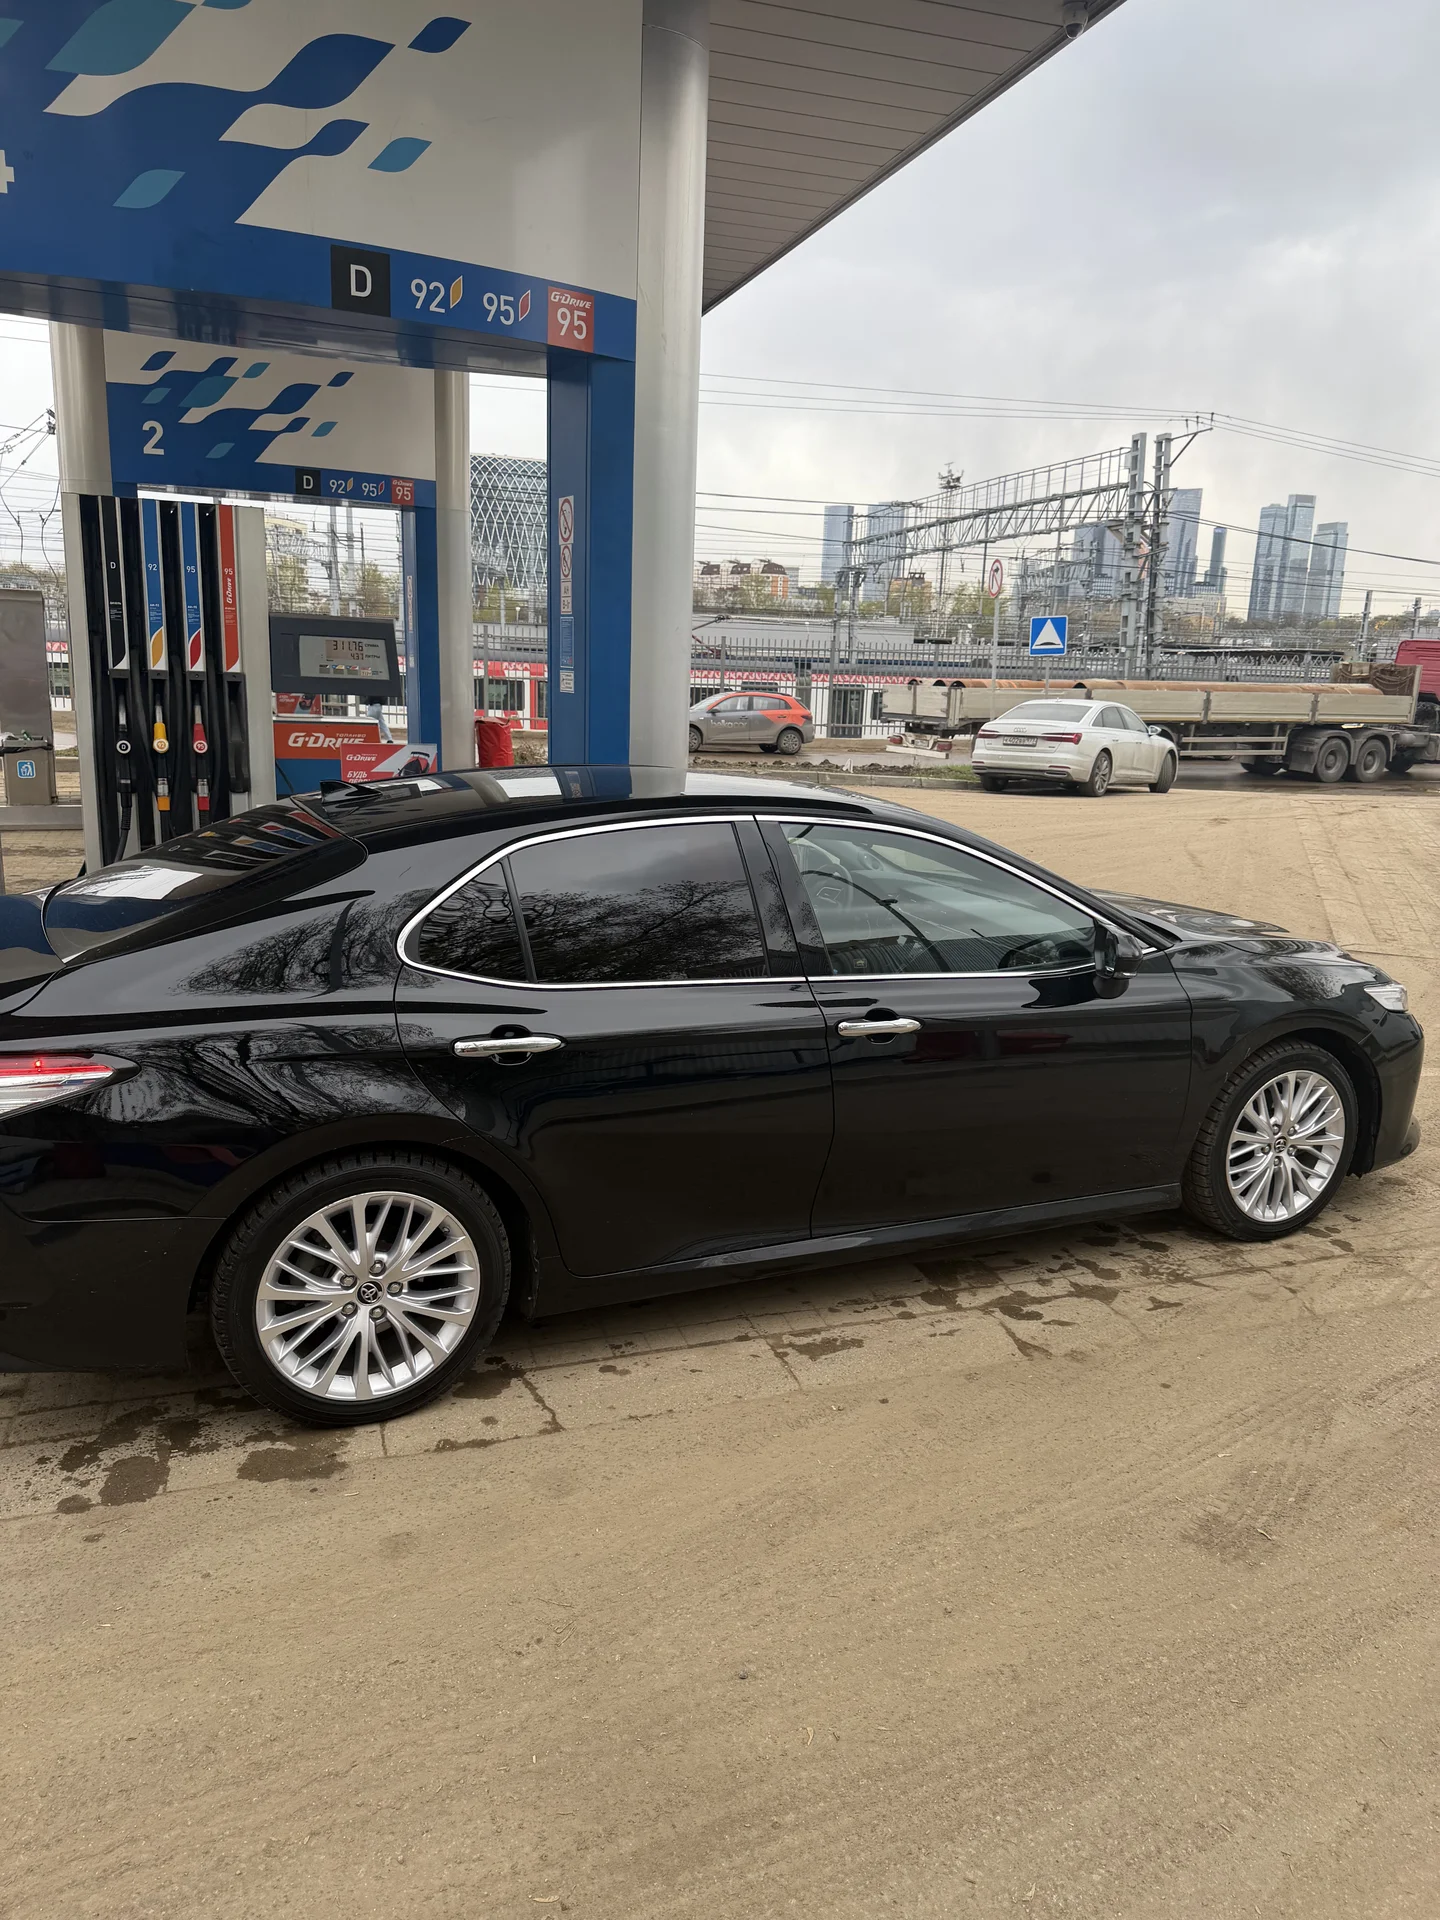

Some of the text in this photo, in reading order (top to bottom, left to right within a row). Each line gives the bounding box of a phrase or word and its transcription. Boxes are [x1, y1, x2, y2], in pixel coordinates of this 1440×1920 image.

[350, 263, 373, 298] D
[410, 278, 446, 314] 92
[483, 292, 515, 326] 95
[556, 307, 587, 340] 95
[142, 420, 165, 456] 2
[303, 475, 314, 490] D
[329, 479, 346, 494] 92
[361, 482, 378, 497] 95
[395, 486, 411, 501] 95
[110, 561, 117, 569] D
[148, 563, 158, 571] 92
[186, 565, 196, 573] 95
[224, 567, 233, 575] 95
[346, 770, 368, 779] БУДЬ
